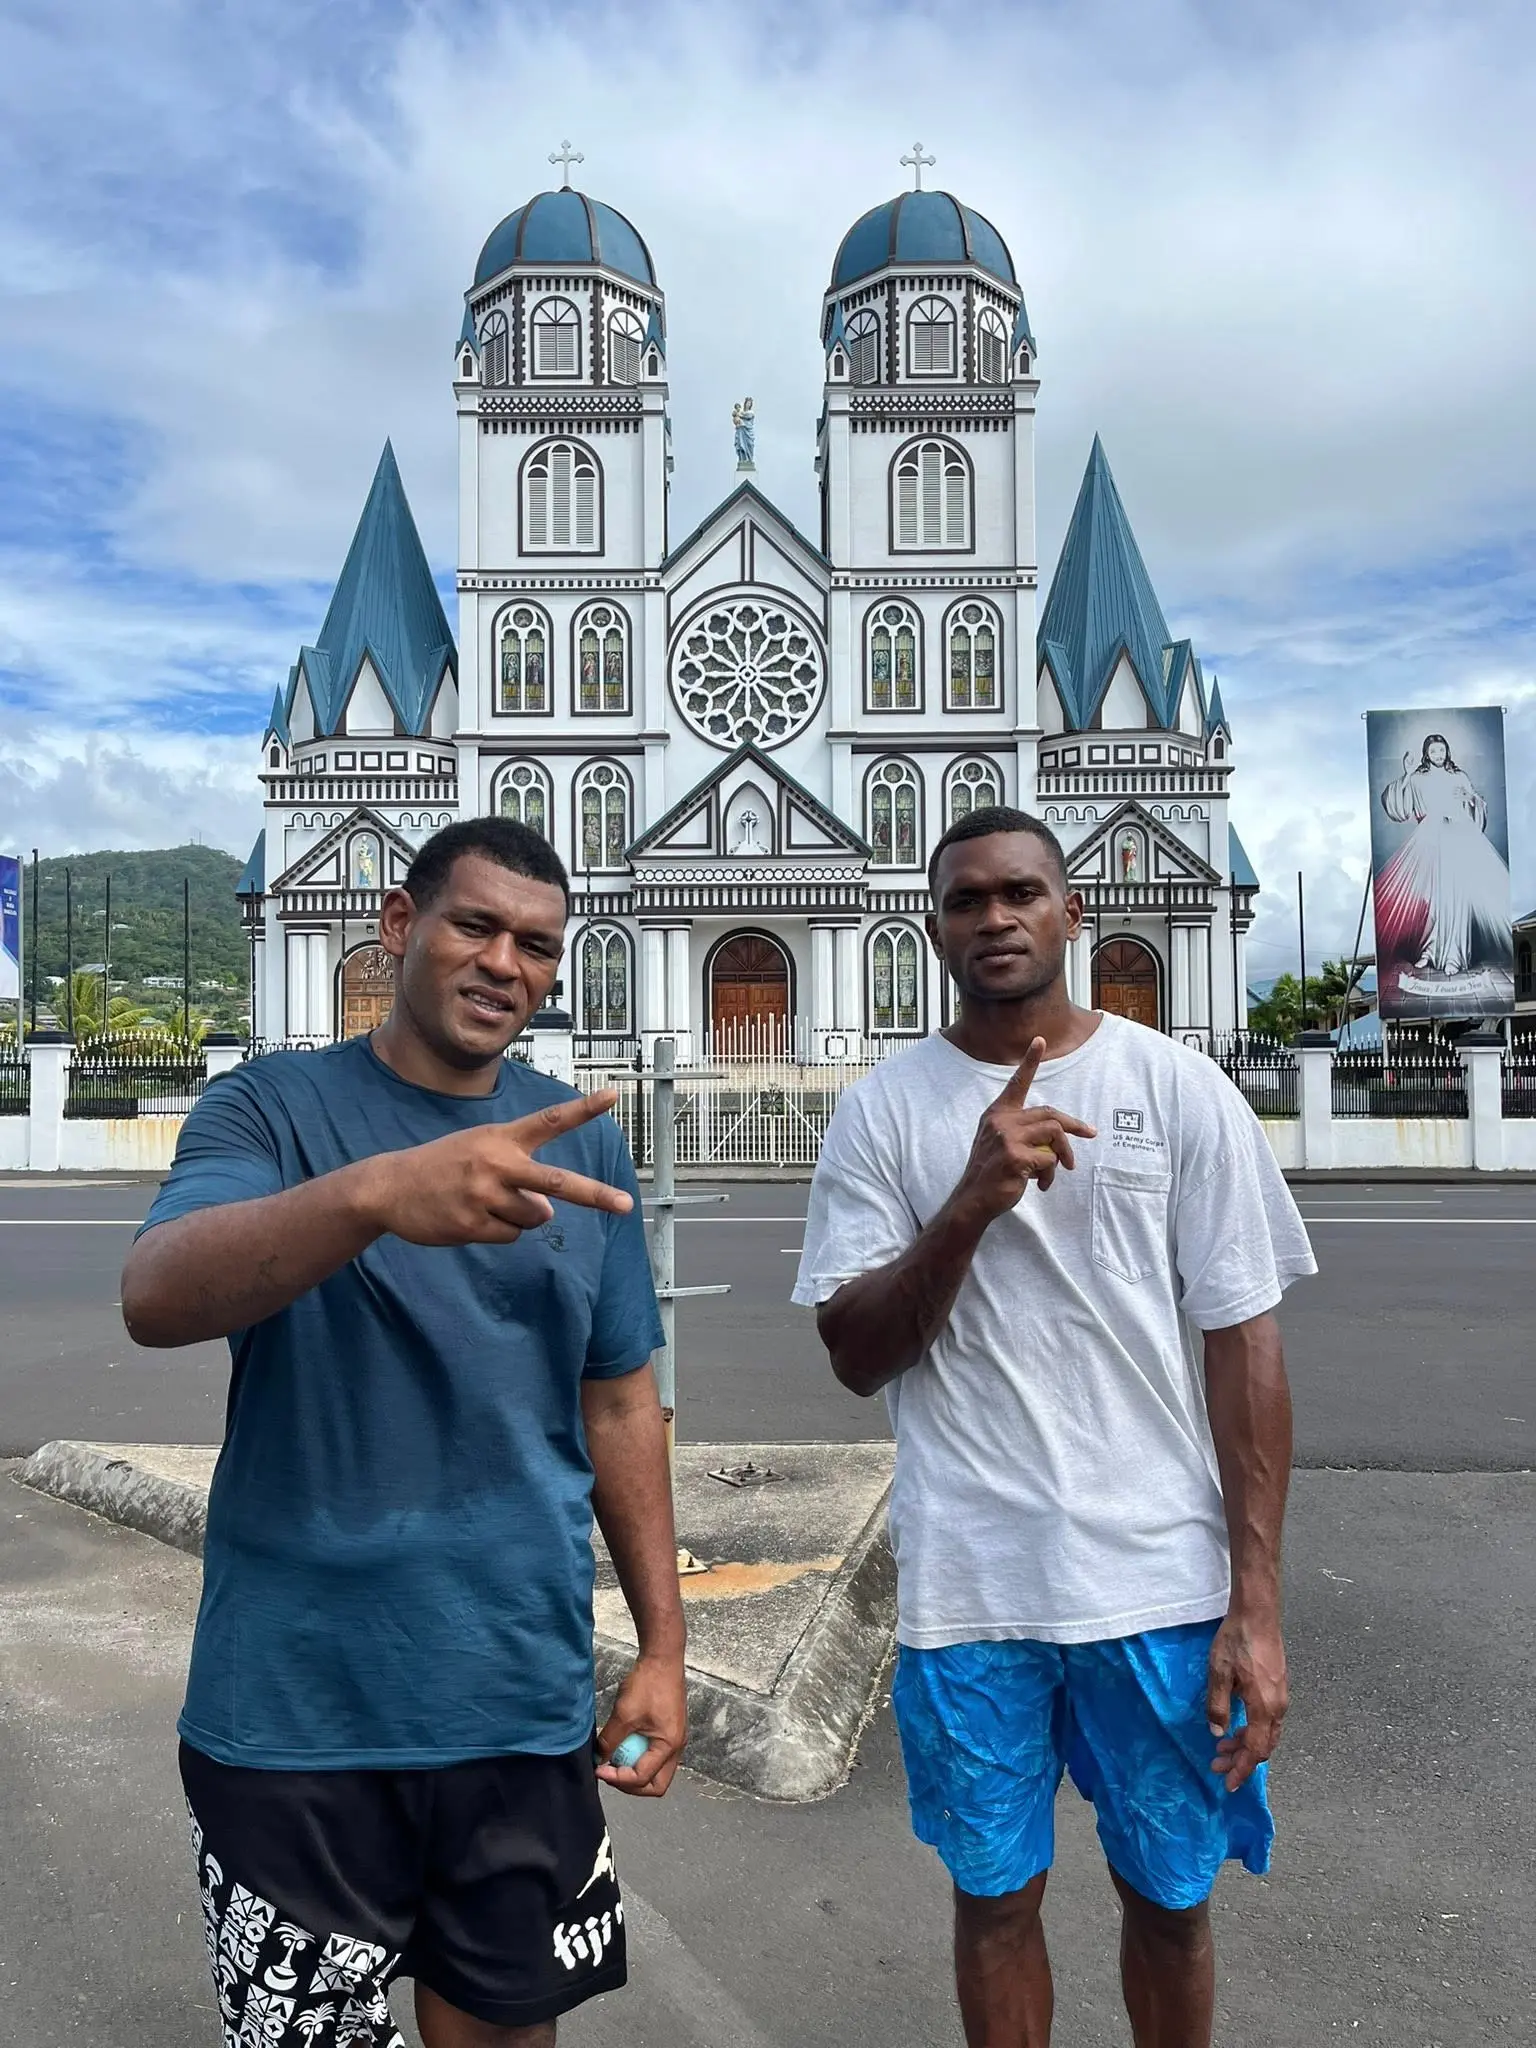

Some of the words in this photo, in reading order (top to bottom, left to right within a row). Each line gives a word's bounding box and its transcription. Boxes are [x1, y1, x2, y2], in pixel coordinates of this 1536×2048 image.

[1125, 1135, 1143, 1143] Army
[1145, 1138, 1164, 1147] Corps
[1122, 1142, 1156, 1152] Engineers
